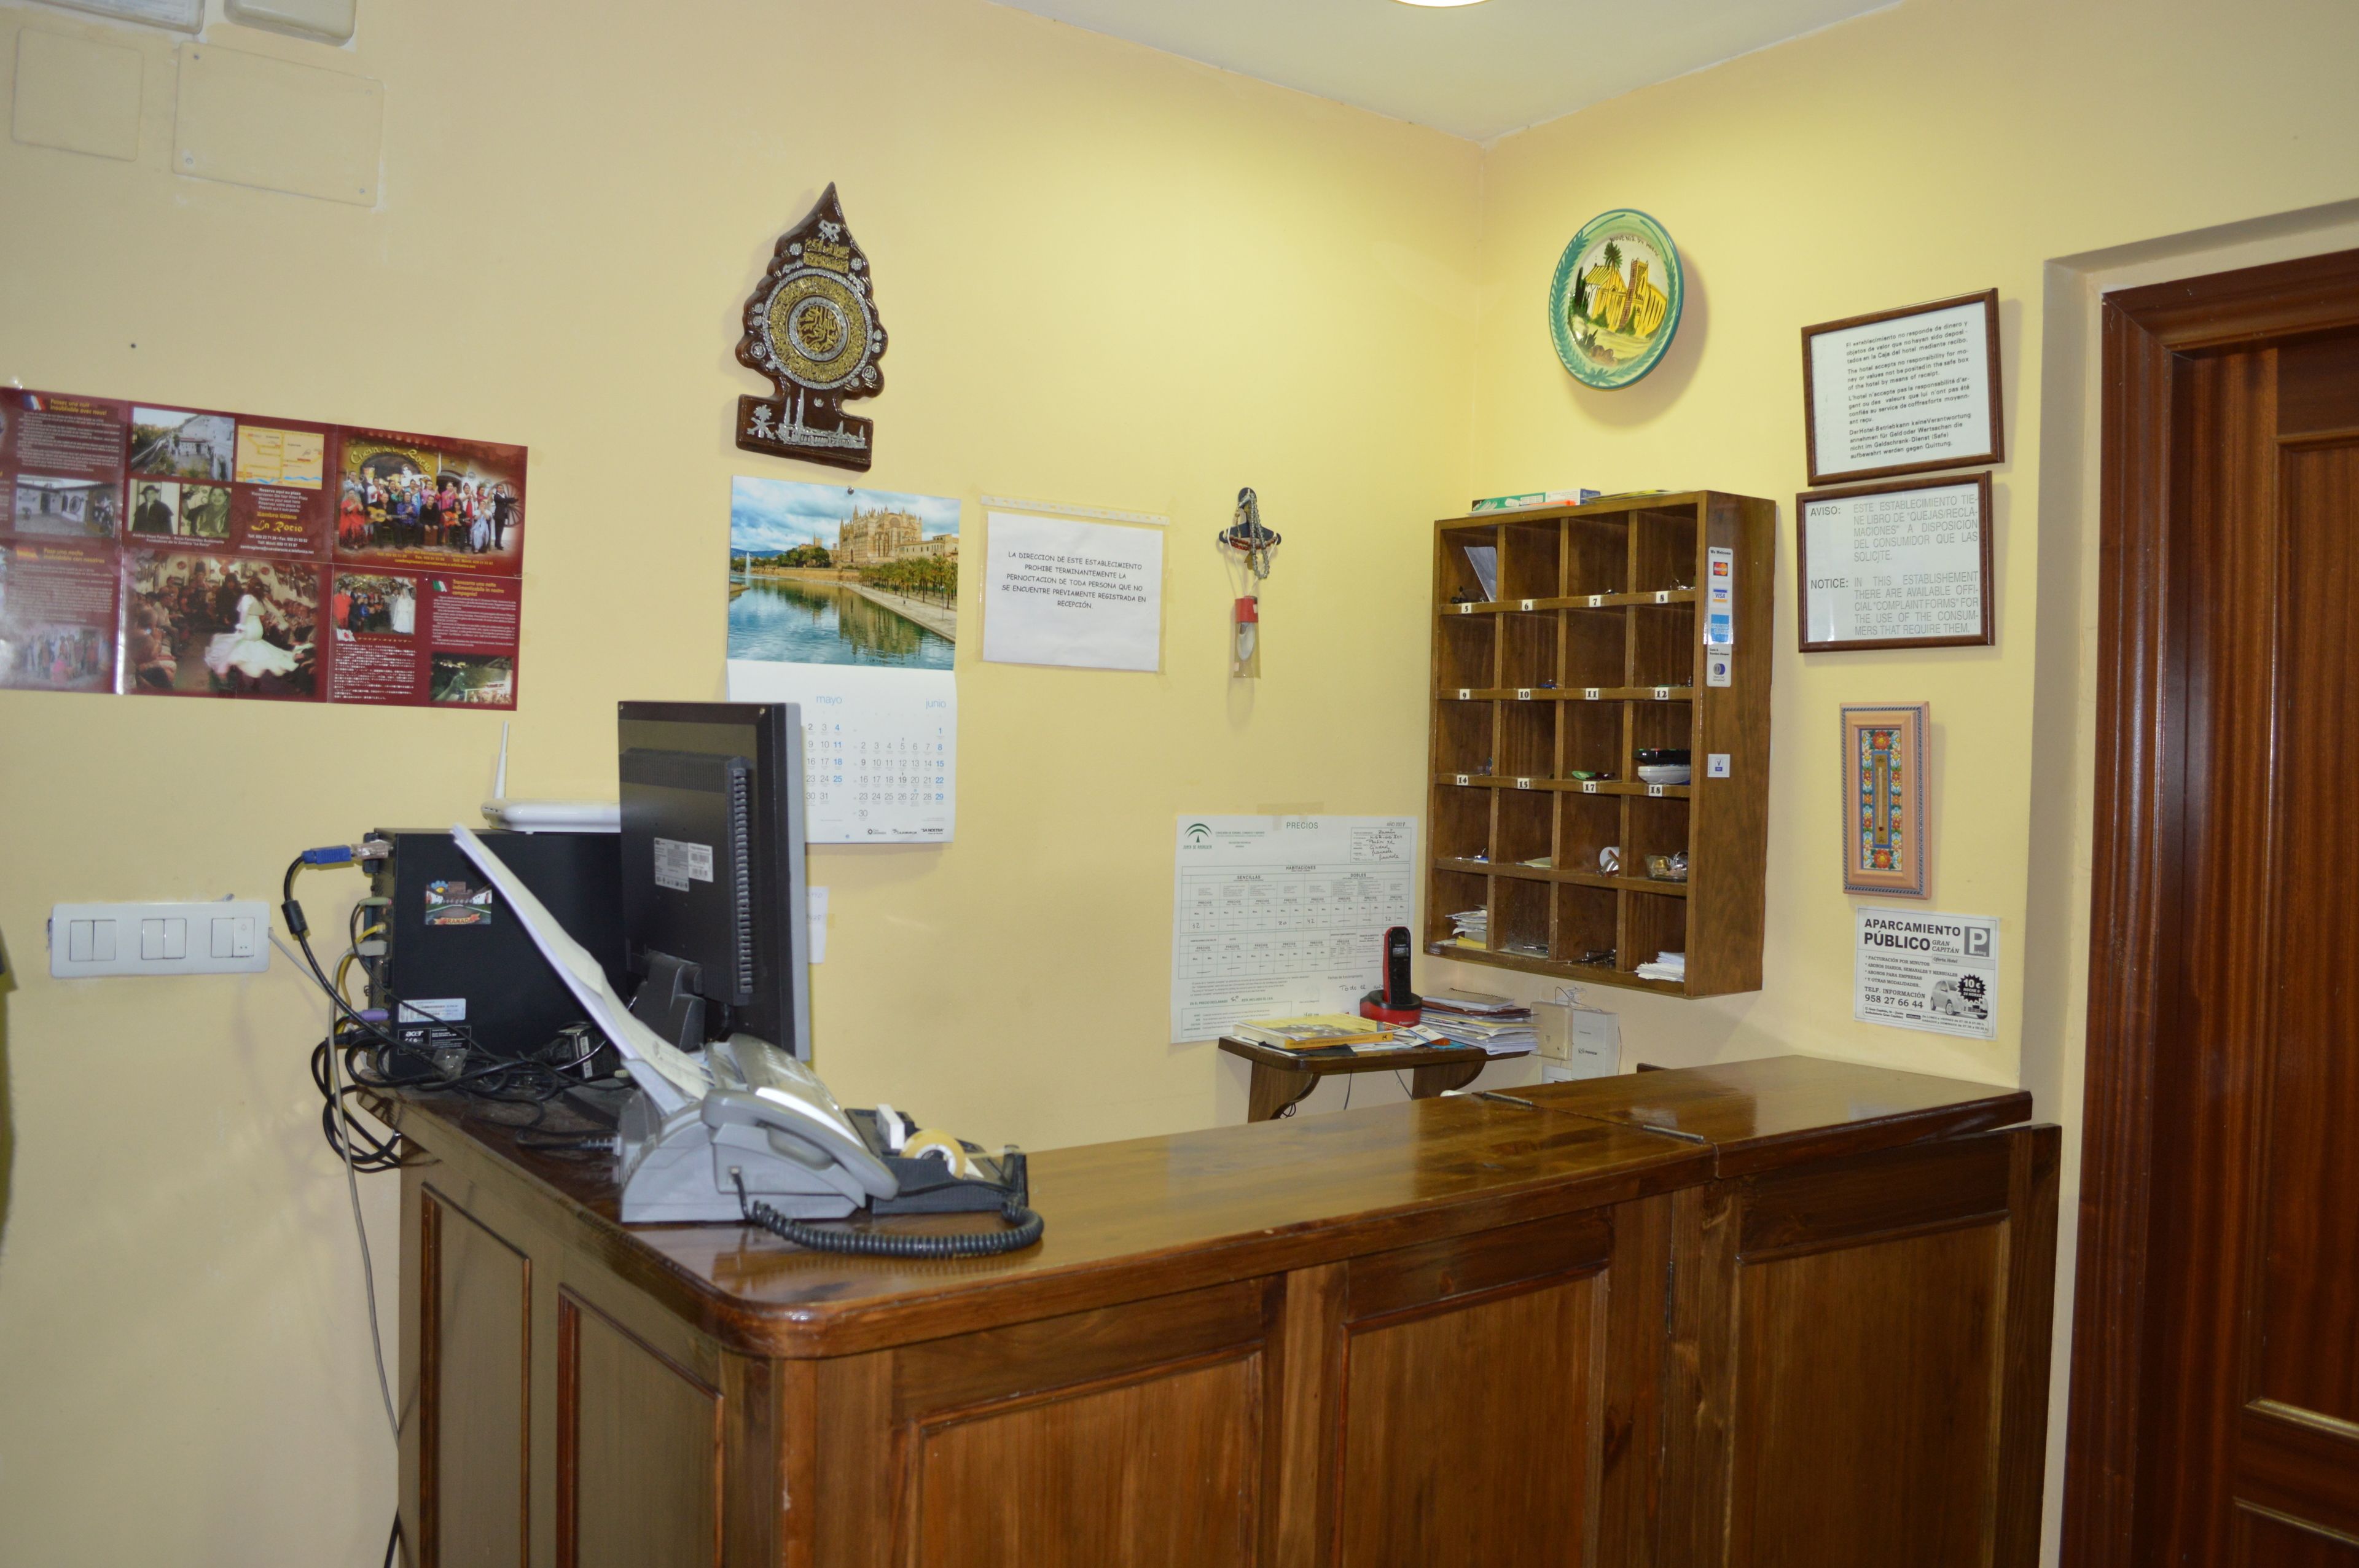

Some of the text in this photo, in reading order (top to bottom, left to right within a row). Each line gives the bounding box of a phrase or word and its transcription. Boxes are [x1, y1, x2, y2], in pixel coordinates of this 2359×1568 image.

[1906, 353, 1944, 364] responsibility
[1850, 450, 1881, 459] aufbewahrt
[1853, 493, 1978, 513] ESTE ESTABLECIMIENTO TIE-
[1810, 506, 1841, 516] AVISO:
[1853, 515, 1864, 525] NE
[1866, 513, 1891, 524] LIBRO
[1893, 512, 1905, 523] DE
[1853, 519, 1978, 536] MACIONES" A DISPOSICION
[1854, 531, 1978, 549] DEL CONSUMIDOR QUE LAS
[1019, 552, 1055, 561] DIRECCION
[1085, 558, 1142, 569] ESTABLECIMIENTO
[1025, 564, 1052, 572] PROHIBE
[1055, 567, 1116, 578] TERMINANTEMENTE
[1006, 573, 1057, 583] PERNOCTACION
[1810, 578, 1848, 589] NOTICE:
[1854, 571, 1978, 587] IN THIS ESTABLISHEMENT
[1012, 585, 1050, 594] ENCUENTRE
[1052, 588, 1096, 598] PREVIAMENTE
[1098, 593, 1135, 601] REGISTRADA
[1854, 584, 1978, 599] THERE ARE AVAILABLE OFFI-
[1854, 596, 1979, 611] CIAL "COMPLAINT FORMS" FOR
[1854, 610, 1979, 623] THE USE OF THE CONSUM-
[1855, 623, 1970, 635] MERS THAT REQUIRE THEM.
[816, 695, 842, 706] mayo
[925, 700, 946, 709] junio
[1864, 919, 1960, 936] APARCAMIENTO
[1864, 930, 1930, 950] PÚBLICO
[1970, 929, 1987, 953] P
[1964, 979, 1975, 988] 10
[1864, 994, 1881, 1003] 958
[1882, 988, 1925, 998] INFORMACIÓN
